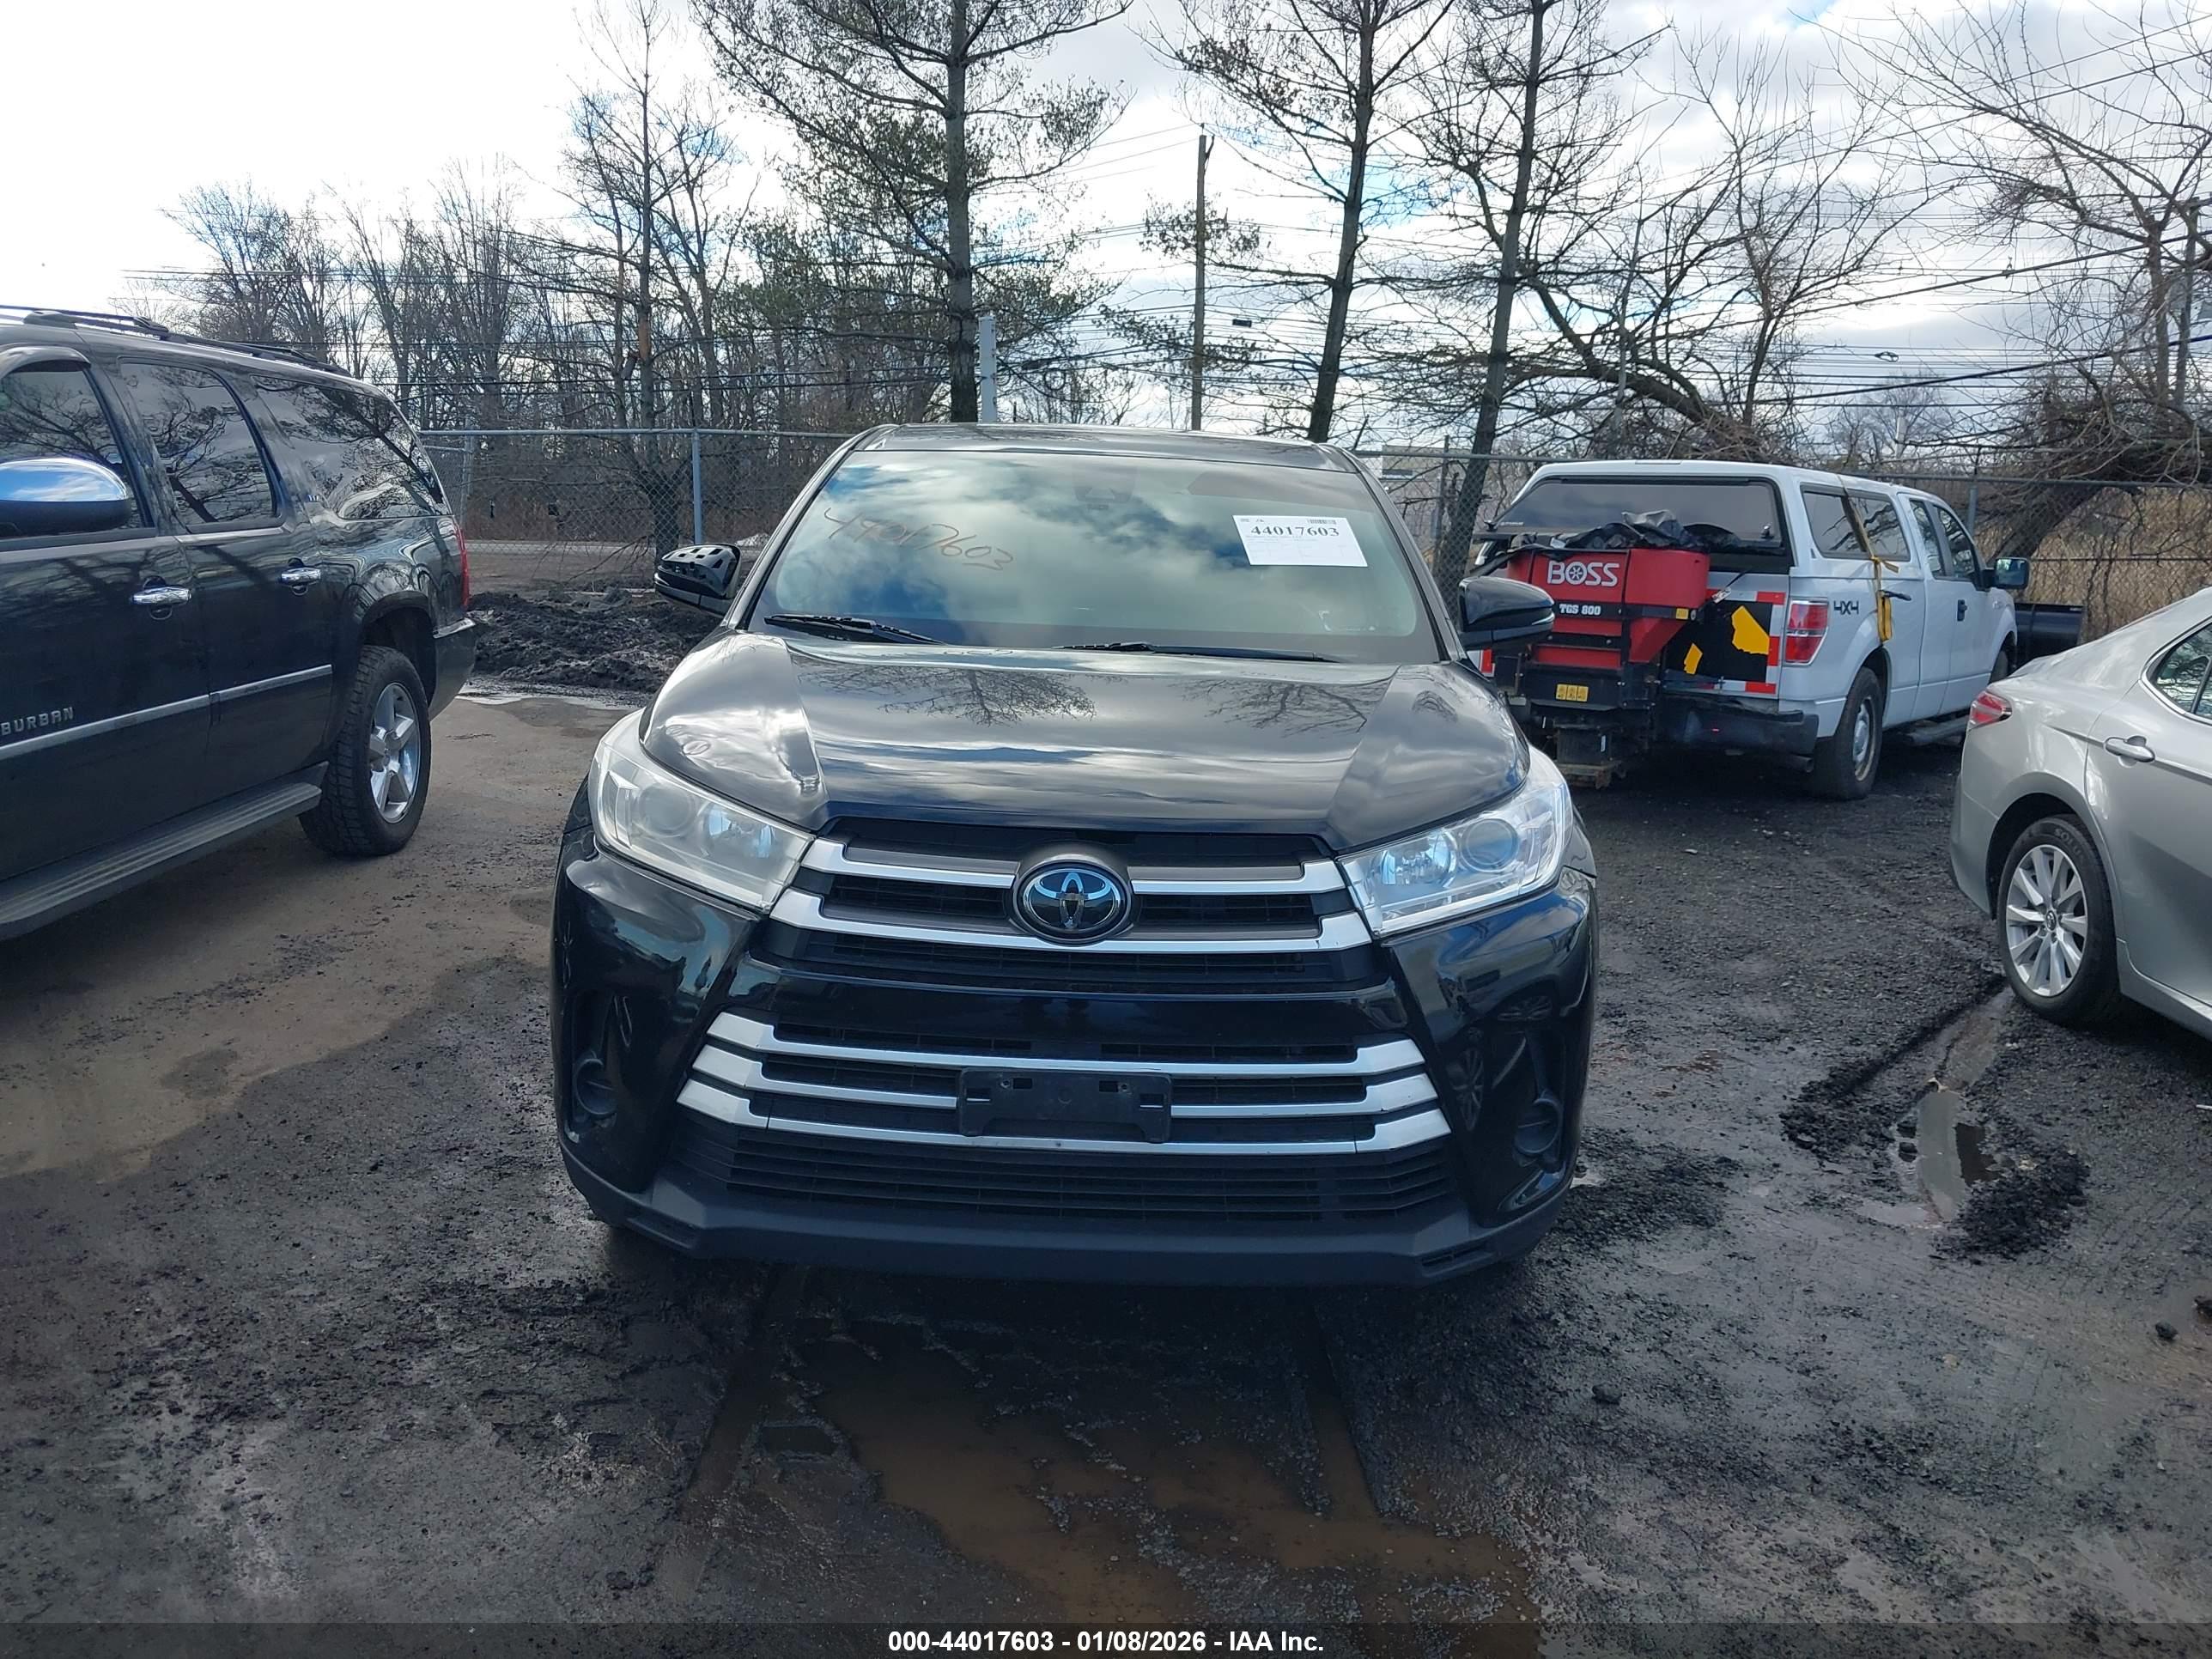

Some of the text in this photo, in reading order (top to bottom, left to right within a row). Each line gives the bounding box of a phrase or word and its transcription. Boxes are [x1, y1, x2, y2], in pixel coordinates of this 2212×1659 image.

[1250, 526, 1340, 537] 44017603
[1547, 560, 1620, 587] BOSS
[1559, 604, 1601, 616] TGS 800
